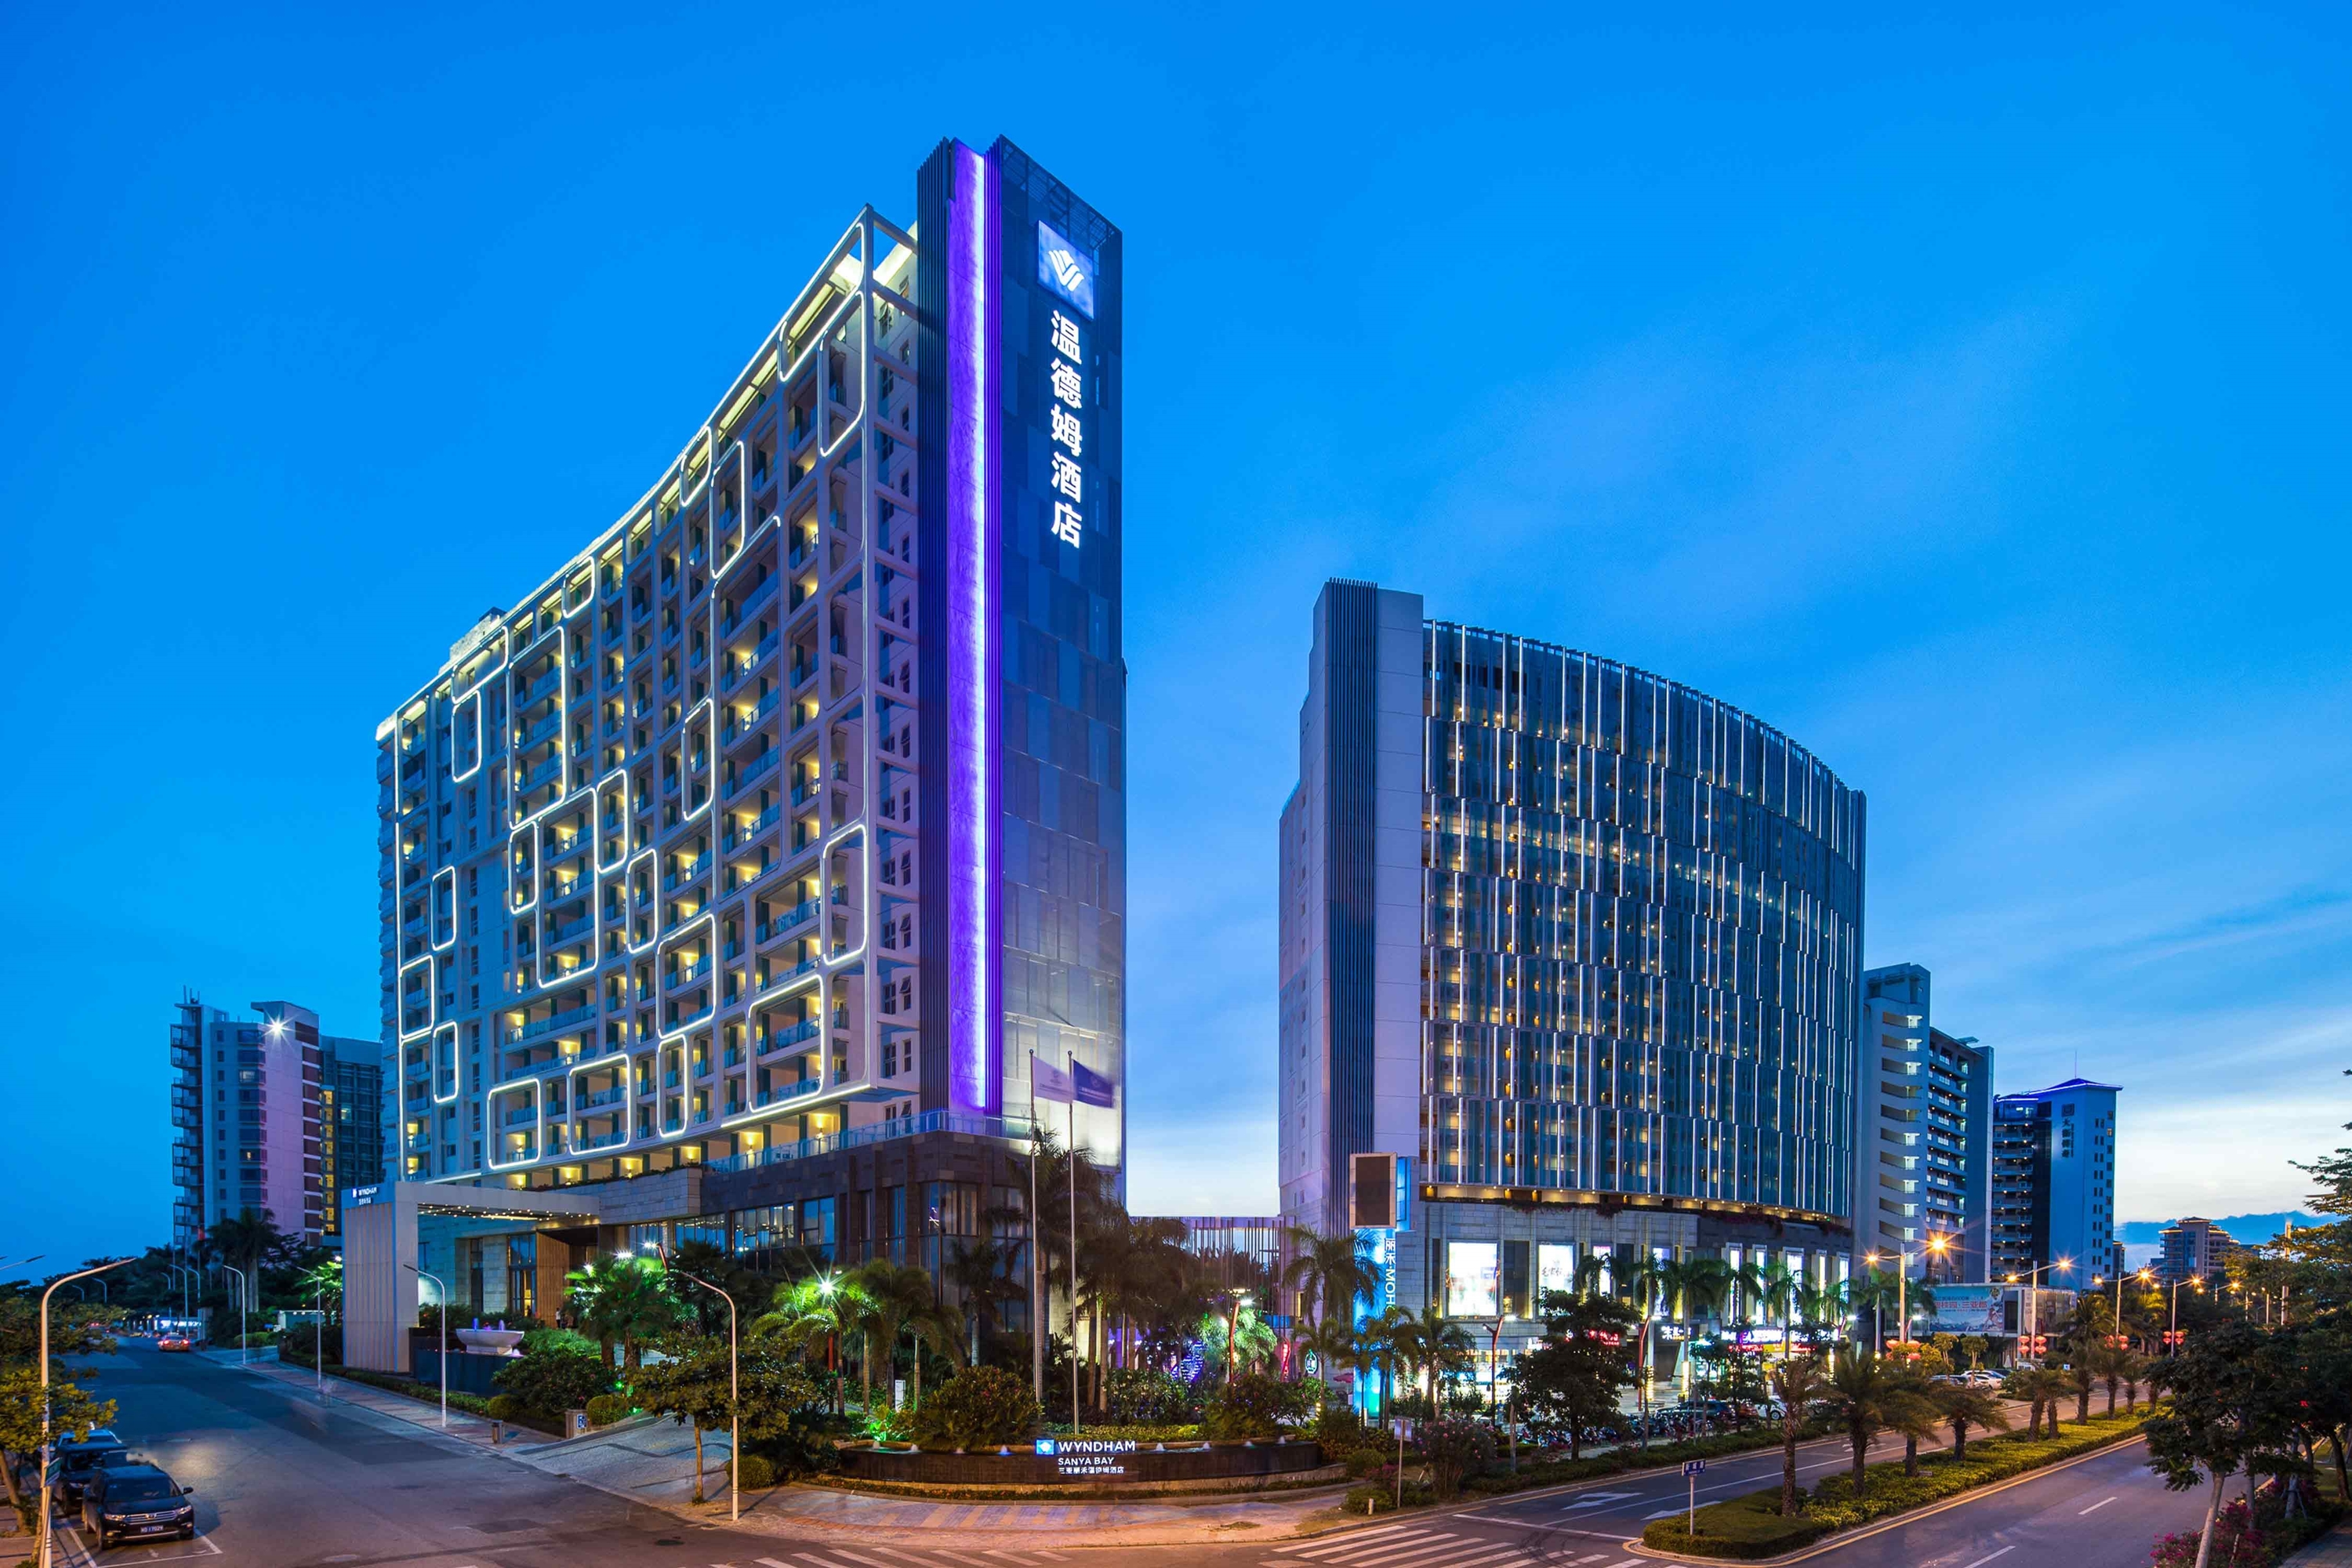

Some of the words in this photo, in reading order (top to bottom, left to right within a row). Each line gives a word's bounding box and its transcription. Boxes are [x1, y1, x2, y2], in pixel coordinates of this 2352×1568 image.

[1050, 309, 1083, 549] 温德姆酒店
[1058, 1440, 1136, 1453] WYNDHAM
[1058, 1457, 1092, 1466] SANYA
[1094, 1456, 1115, 1465] BAY
